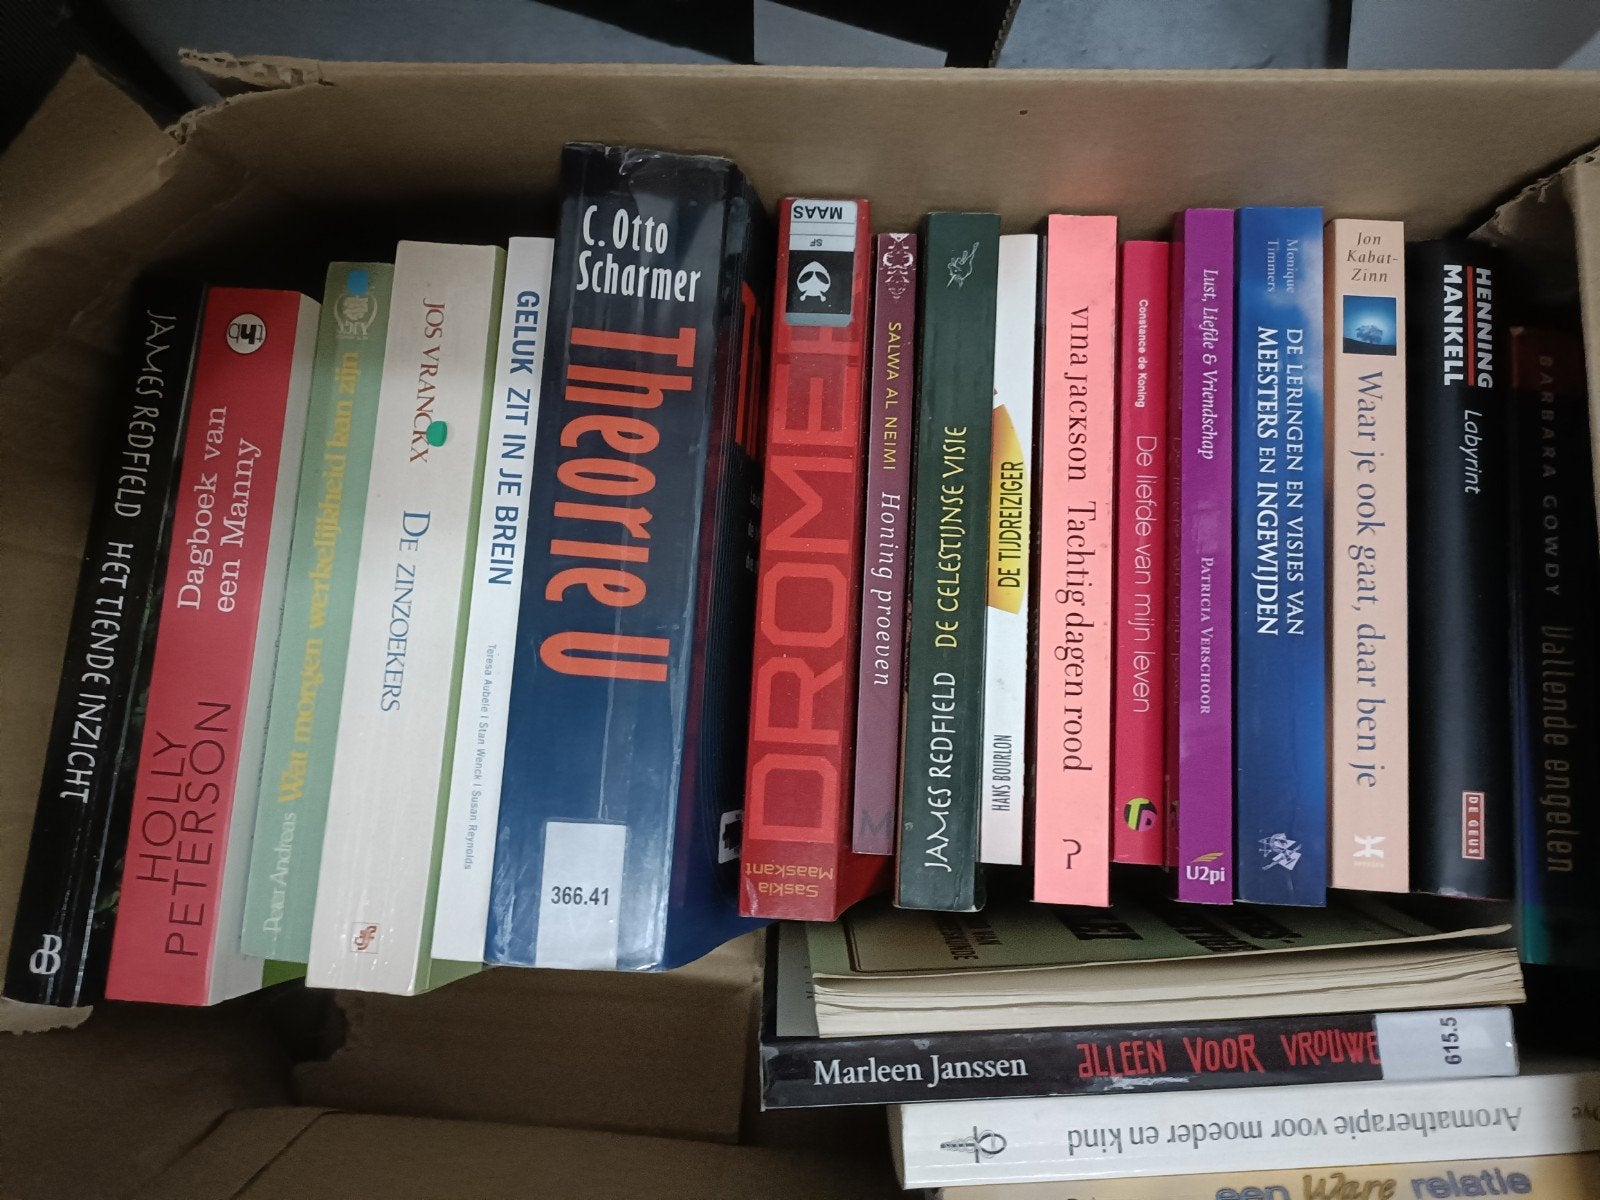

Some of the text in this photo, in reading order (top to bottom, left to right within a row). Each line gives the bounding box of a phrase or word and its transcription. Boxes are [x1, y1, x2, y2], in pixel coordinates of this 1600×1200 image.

[612, 208, 669, 255] Otto
[793, 204, 844, 220] MAAS
[809, 238, 823, 247] SF
[1346, 248, 1399, 265] Kabat-
[1357, 231, 1382, 247] Jon
[422, 297, 446, 339] JOS
[576, 250, 702, 303] Scharmer
[1267, 239, 1280, 295] Timmers
[1283, 238, 1299, 294] Monique
[1350, 268, 1389, 284] Zinn
[335, 351, 361, 395] zijn
[1135, 298, 1149, 408] Constance de Koning
[1198, 269, 1219, 460] Lust, Liefde & Vriendschap
[1442, 264, 1464, 386] MANKELL
[1476, 267, 1494, 389] HENNING
[114, 308, 178, 518] JAMES REDFIELD
[327, 399, 353, 448] kan
[487, 289, 541, 587] GELUK ZIT IN JE BREIN
[883, 321, 902, 471] SALWA AL NEIMI
[540, 326, 697, 683] Theorie U
[1251, 326, 1279, 636] MEESTERS EN INGEWIJDEN
[1285, 328, 1305, 635] DE LERINGEN EN VISIES VAN
[1458, 409, 1483, 495] Labyrint
[1538, 355, 1560, 596] BARBARA GOWDY
[177, 405, 227, 610] Dagboek van
[217, 437, 262, 613] een Manny
[308, 453, 347, 629] werkelijkheid
[935, 425, 968, 648] DE CELESTIJNSE VISIE
[997, 460, 1024, 588] DE TIJDREIZIGER
[870, 491, 901, 686] Honing proeven
[1128, 436, 1162, 713] De liefde van mijn leven
[1347, 370, 1387, 788] Waar je ook gaat, daar ben je
[59, 540, 134, 804] HET TIENDE INZICHT
[1053, 500, 1096, 772] Tachtig dagen rood
[294, 638, 325, 743] morgen
[463, 643, 498, 871] Teresa Aubele Stan Wenck Susan Reynolds
[924, 671, 956, 872] JAMES REDFIELD
[991, 734, 1012, 812] HANS BOURLON
[1540, 624, 1581, 874] Vallende engelen
[136, 730, 188, 883] HOLLY
[164, 701, 232, 957] PETERSON
[269, 812, 298, 887] Andreas
[1467, 795, 1480, 855] DE GEUS
[549, 886, 611, 907] 366.41
[745, 862, 834, 880] Maaskant
[758, 881, 819, 897] Saskia
[1185, 866, 1226, 886] U2pi
[813, 1054, 1029, 1088] Marleen Janssen
[1182, 1033, 1265, 1074] VOOR
[1438, 1016, 1463, 1065] 615.5
[1067, 1106, 1523, 1156] Aromatherapie voor moeder en kind
[1301, 1171, 1399, 1200] Ware
[1410, 1167, 1533, 1199] relatie
